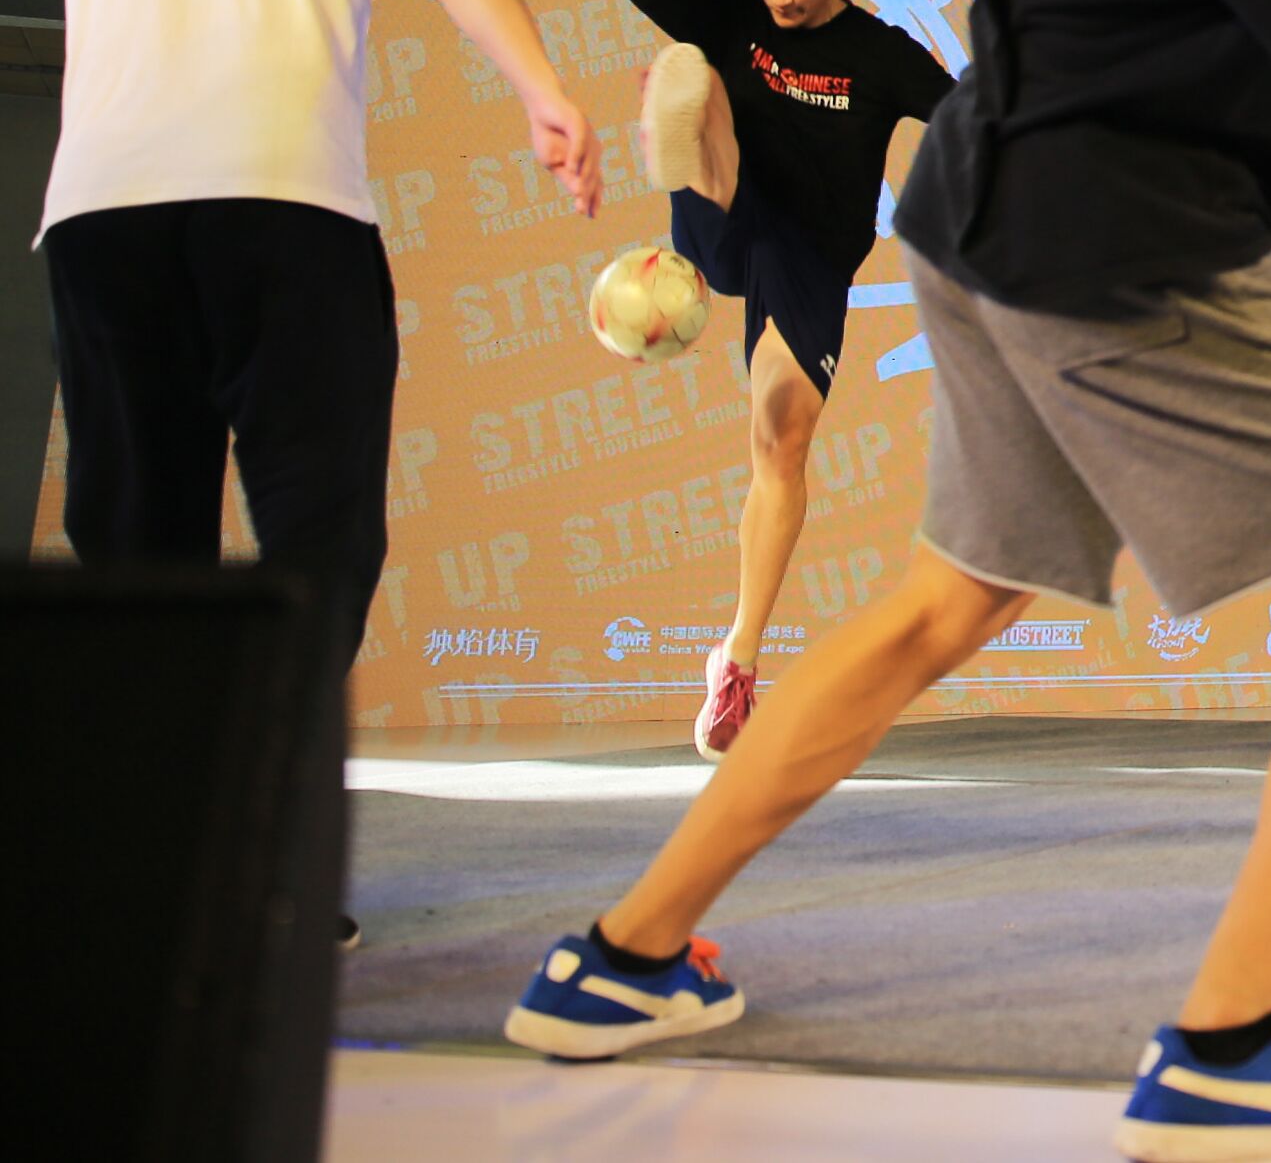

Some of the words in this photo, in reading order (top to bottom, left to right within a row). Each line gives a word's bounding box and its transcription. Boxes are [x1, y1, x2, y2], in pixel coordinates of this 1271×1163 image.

[470, 354, 701, 473] STREET
[483, 450, 583, 494] FREESTYLE
[593, 420, 685, 462] FOOTBALL
[436, 531, 530, 609] UP
[812, 423, 893, 493] UP
[802, 546, 884, 624] UP
[659, 644, 692, 655] China
